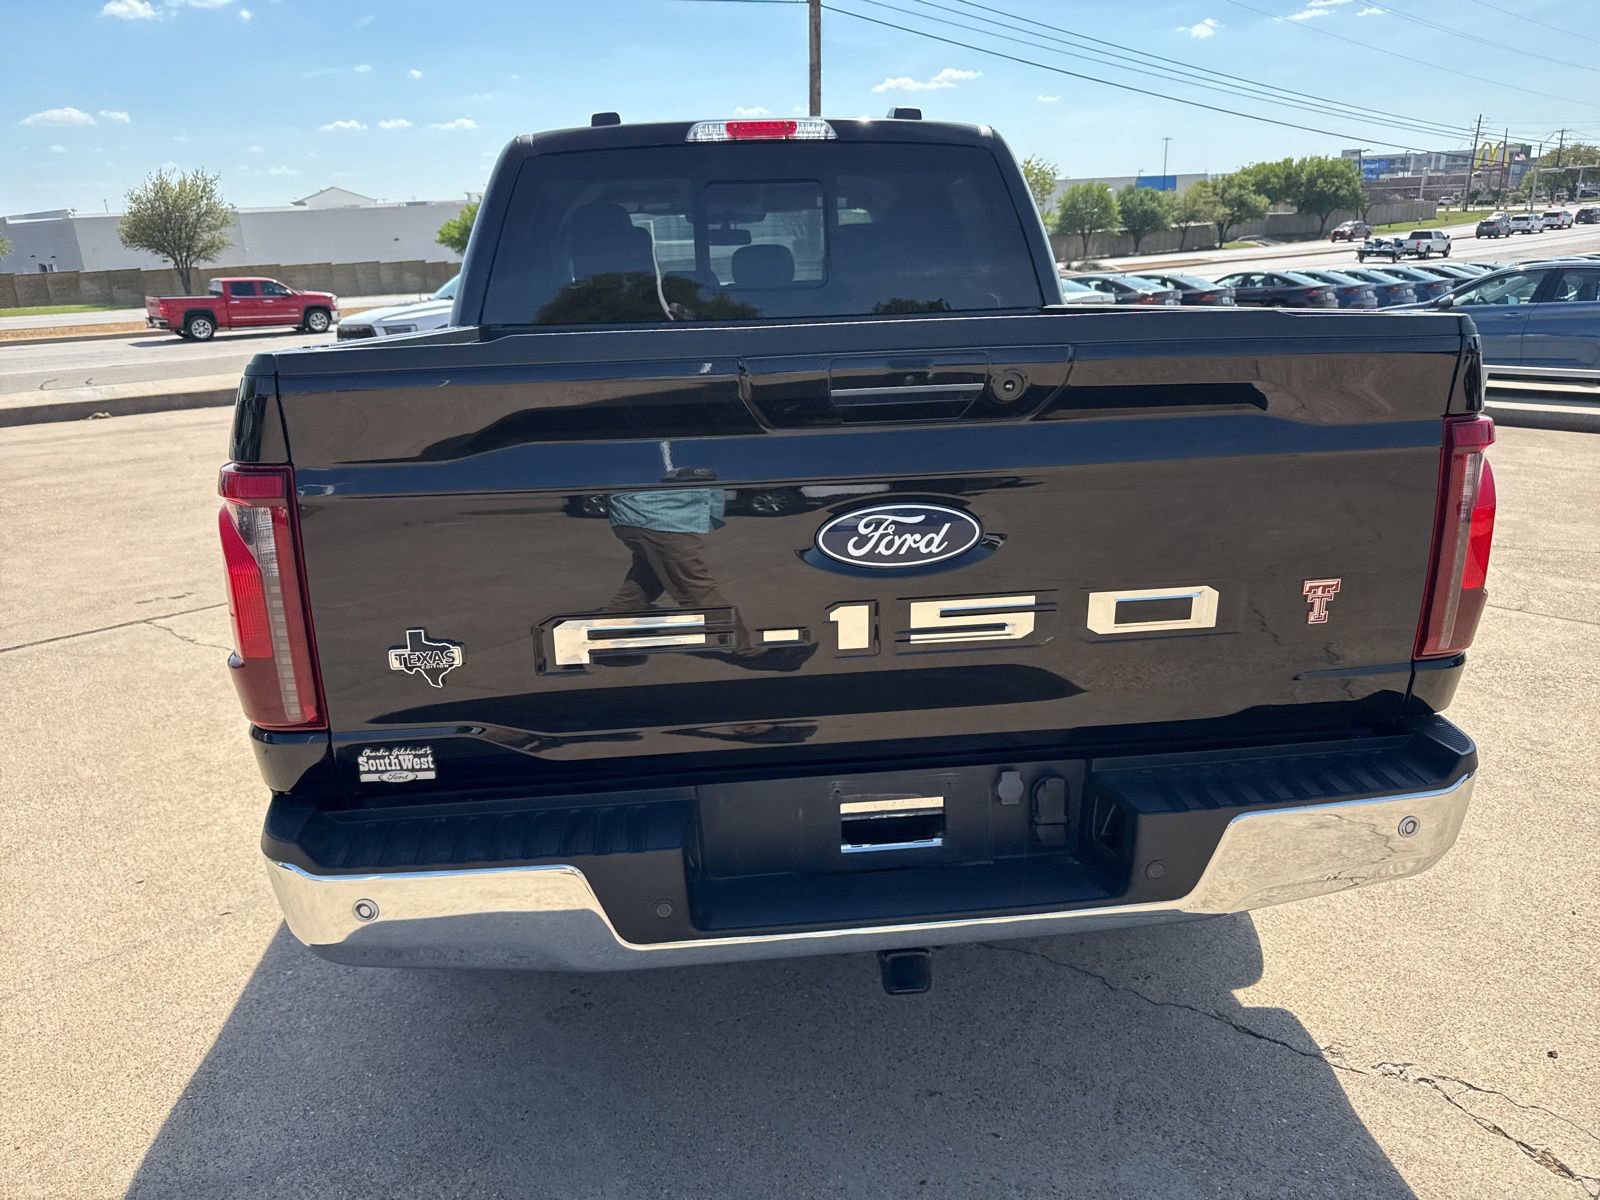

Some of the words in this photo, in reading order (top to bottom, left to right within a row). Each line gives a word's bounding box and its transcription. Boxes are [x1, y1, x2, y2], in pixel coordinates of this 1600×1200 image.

[847, 514, 951, 557] Ford
[552, 585, 1219, 666] F-150
[393, 650, 456, 667] TEXAS
[358, 755, 435, 771] SouthWest
